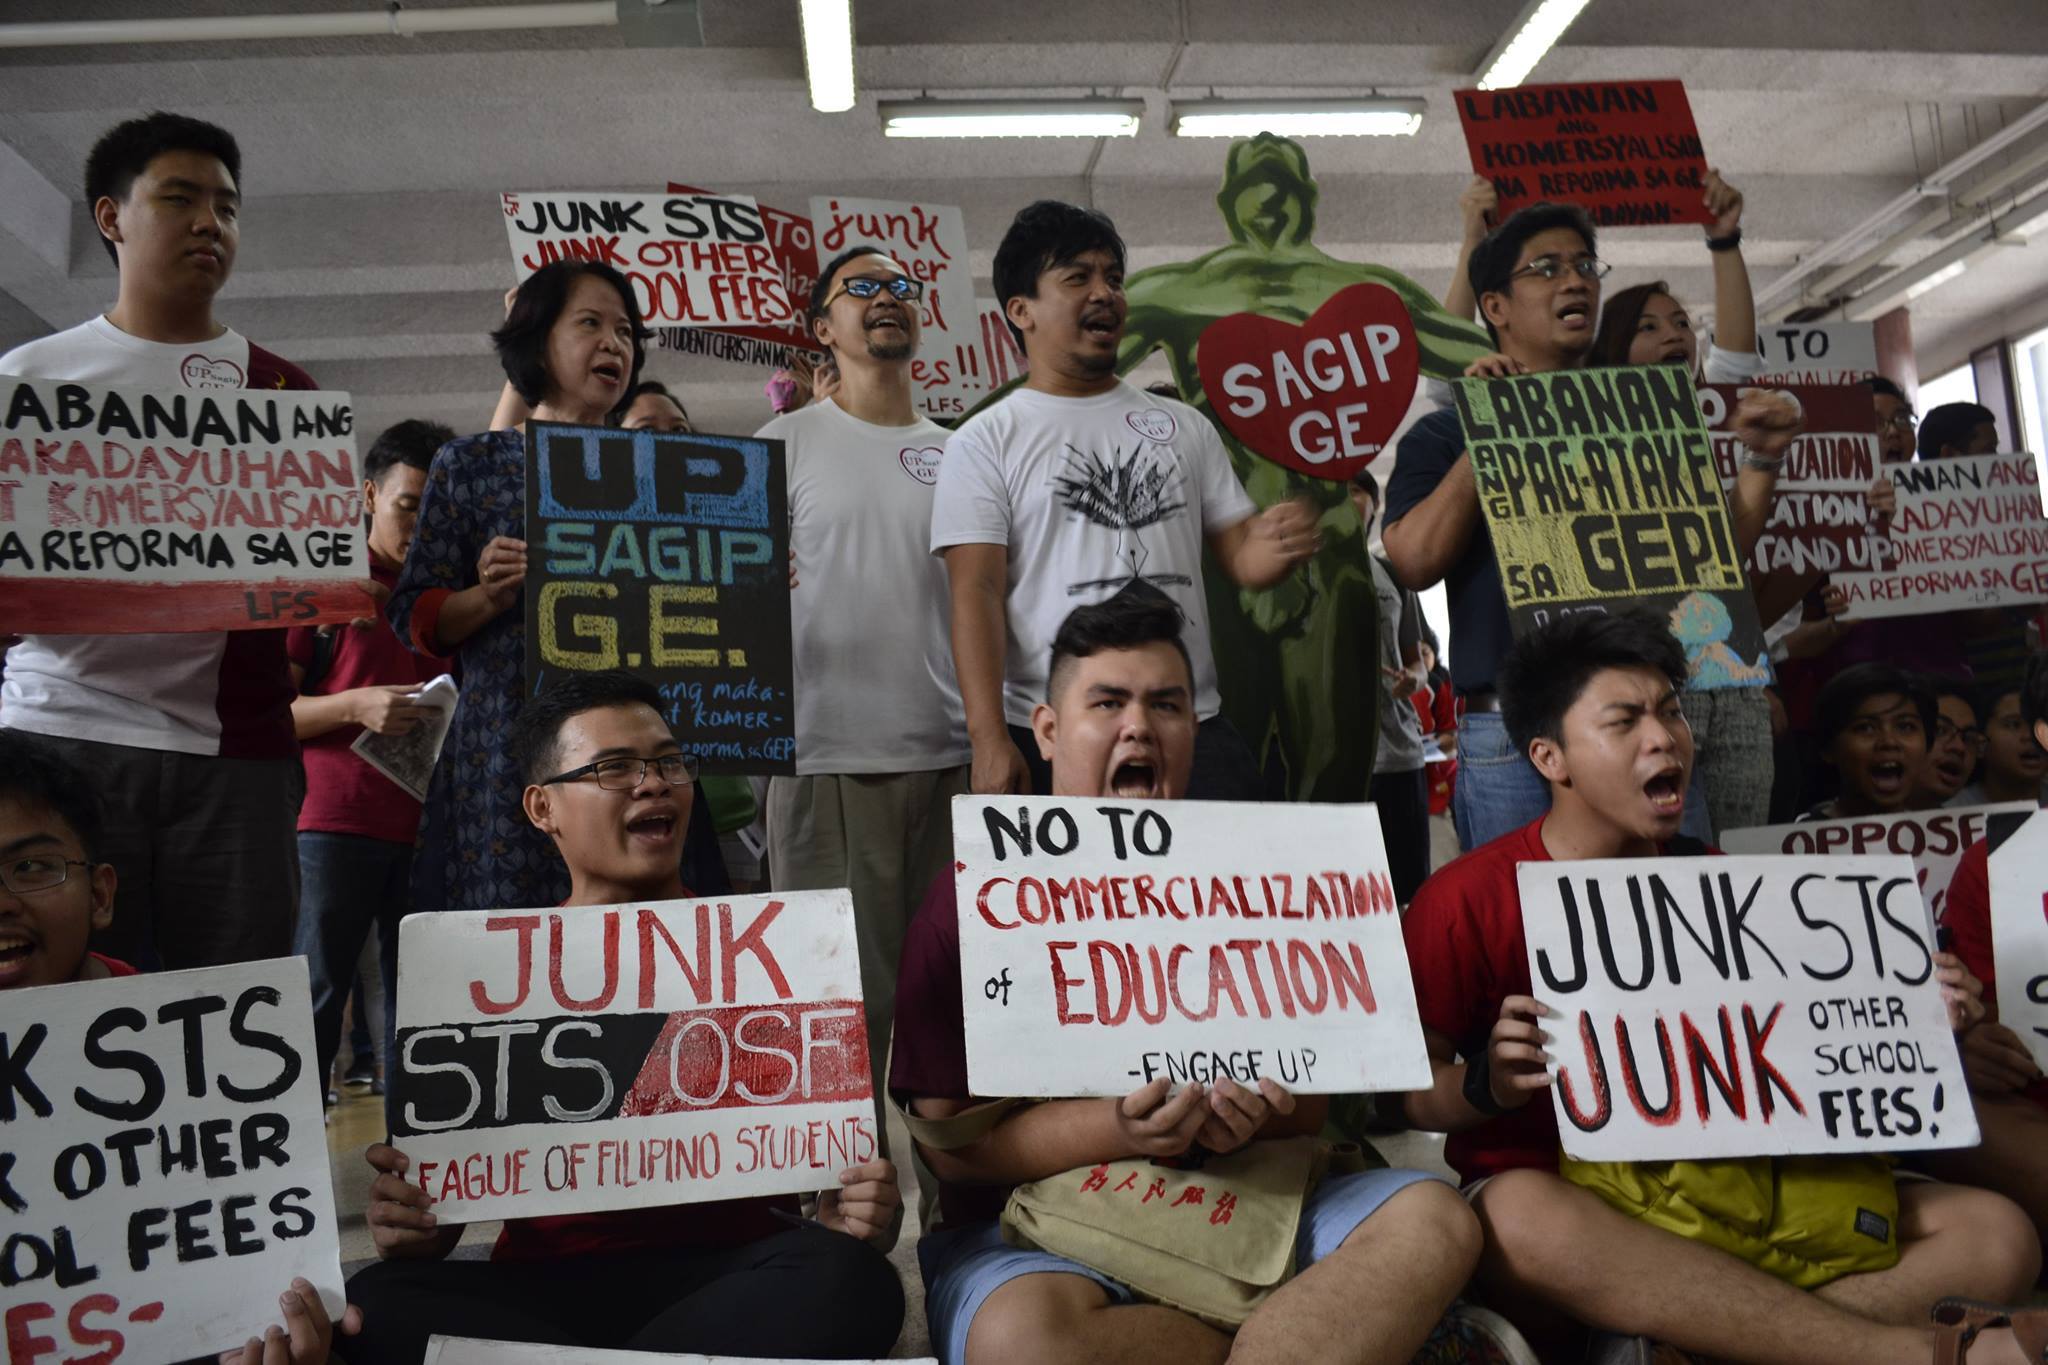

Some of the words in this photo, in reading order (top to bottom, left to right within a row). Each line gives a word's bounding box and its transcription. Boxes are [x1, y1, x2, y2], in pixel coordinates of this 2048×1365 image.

[1464, 86, 1659, 121] LABANAN
[1557, 120, 1598, 134] ANG
[1539, 166, 1639, 196] REPORMA
[516, 200, 650, 234] JUNK
[664, 198, 765, 242] STS
[767, 212, 812, 250] TO
[823, 200, 951, 260] junk
[637, 240, 780, 275] OTHER
[628, 271, 709, 322] OOL
[709, 274, 794, 324] FEES
[1222, 323, 1401, 418] SAGIP
[1776, 329, 1830, 363] TO
[0, 383, 281, 446] ABANAN
[293, 404, 354, 439] ANG
[1289, 402, 1382, 464] G.E.
[1452, 369, 1700, 441] LABANAN
[0, 438, 356, 490] AKADAYUHAN
[545, 432, 753, 520] UP
[1474, 445, 1512, 519] ANG
[1500, 432, 1719, 517] PAG-ATAKE
[1987, 459, 2038, 488] ANG
[0, 480, 23, 522] T
[0, 531, 34, 571] A
[41, 530, 234, 571] REPORMA
[247, 531, 298, 567] SA
[305, 531, 354, 568] GE
[545, 523, 773, 586] SAGIP
[1506, 561, 1559, 598] SA
[1571, 510, 1739, 590] GEP!
[245, 591, 320, 621] LFS
[1870, 570, 1978, 601] REPORMA
[1981, 567, 2010, 589] SA
[537, 580, 748, 671] G.E.
[982, 806, 1079, 861] NO
[1096, 807, 1172, 860] TO
[976, 871, 1395, 930] COMMERCIALIZATION
[469, 900, 793, 1015] JUNK
[1536, 873, 1788, 994] JUNK
[1790, 873, 1933, 986] STS
[985, 967, 1013, 1007] of
[1046, 938, 1377, 1028] EDUCATION
[74, 986, 301, 1122] STS
[403, 1022, 614, 1130] STS
[670, 1008, 857, 1105] OSF
[1278, 1048, 1317, 1083] UP
[1557, 1001, 1808, 1134] JUNK
[1808, 996, 1908, 1031] OTHER
[1815, 1042, 1939, 1076] SCHOOL
[1818, 1082, 1946, 1140] FEES!
[54, 1112, 290, 1200] OTHER
[399, 1148, 532, 1204] EAGUE
[544, 1142, 591, 1193] OF
[597, 1132, 721, 1187] FILIPINO
[736, 1116, 876, 1174] STUDENTS
[128, 1187, 315, 1272] FEES
